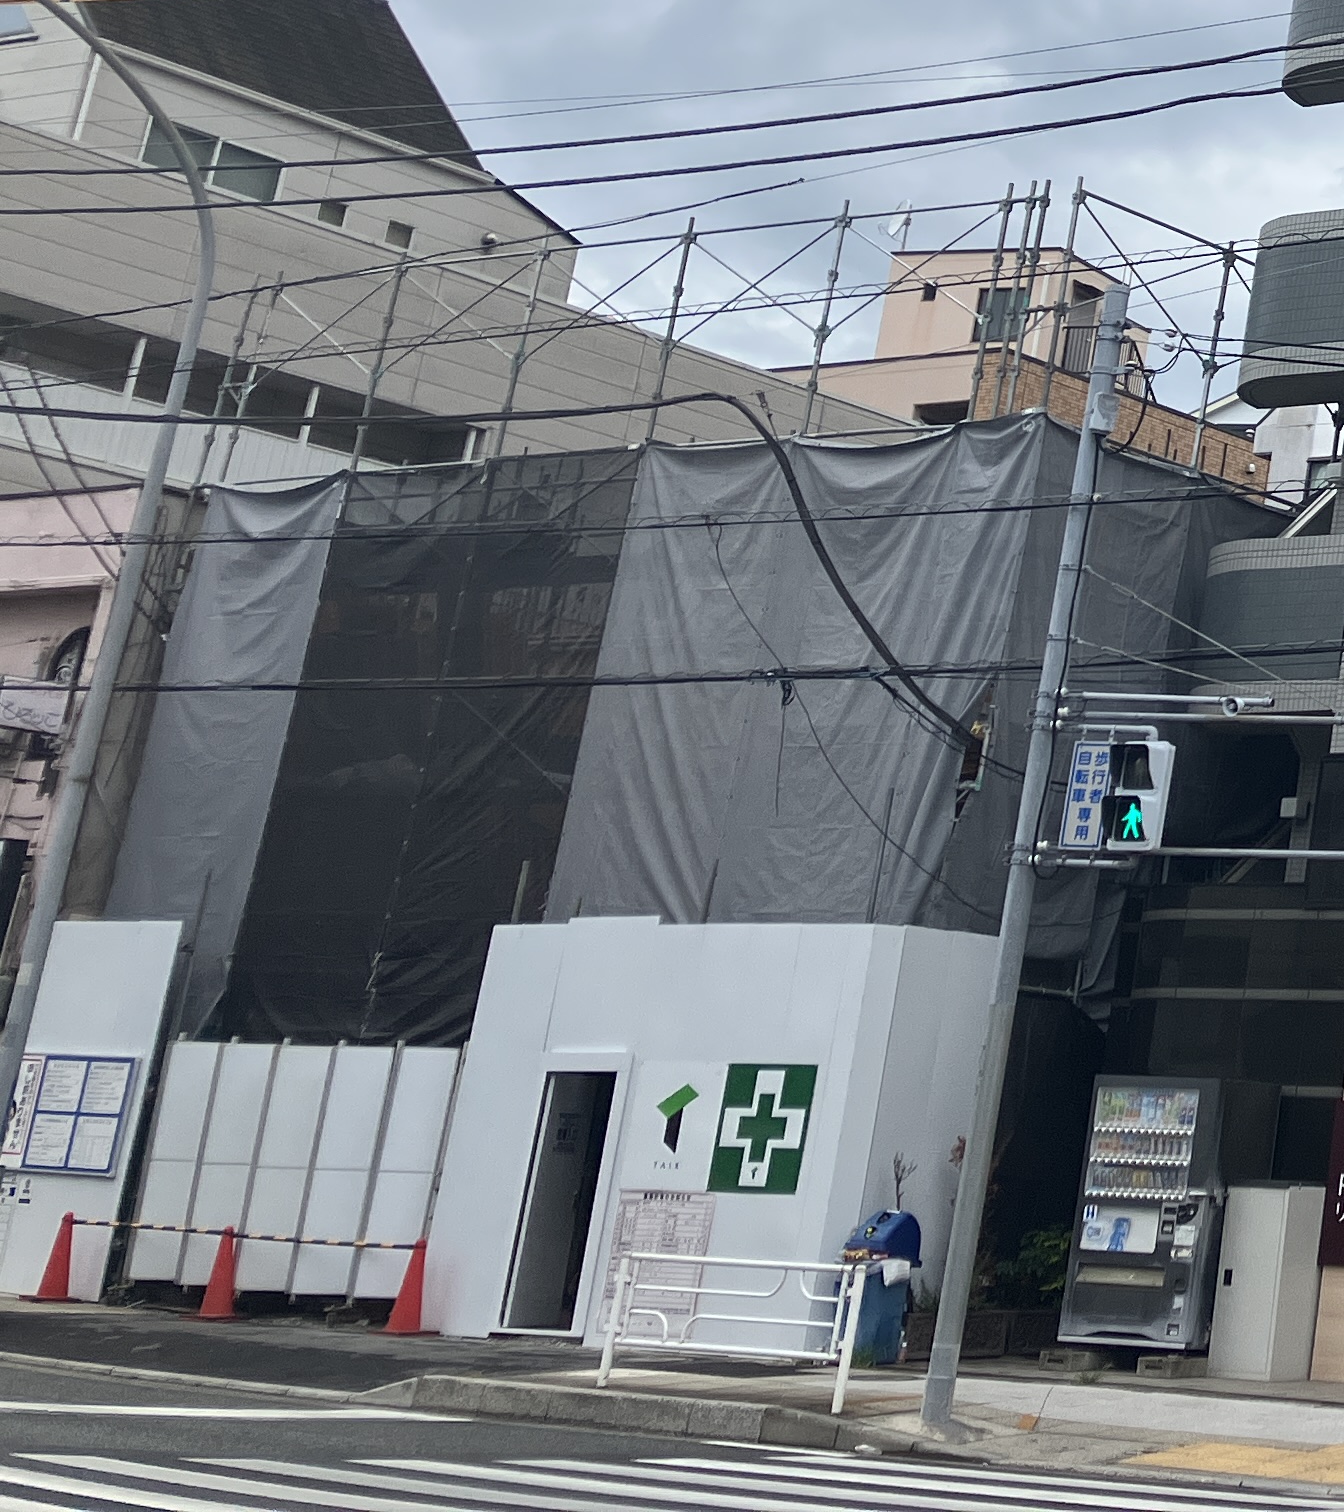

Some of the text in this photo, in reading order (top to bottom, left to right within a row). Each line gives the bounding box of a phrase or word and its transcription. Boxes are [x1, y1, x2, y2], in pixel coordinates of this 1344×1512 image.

[1072, 751, 1092, 803] 自転車
[1090, 751, 1109, 804] 歩行者
[1074, 807, 1092, 840] 専用
